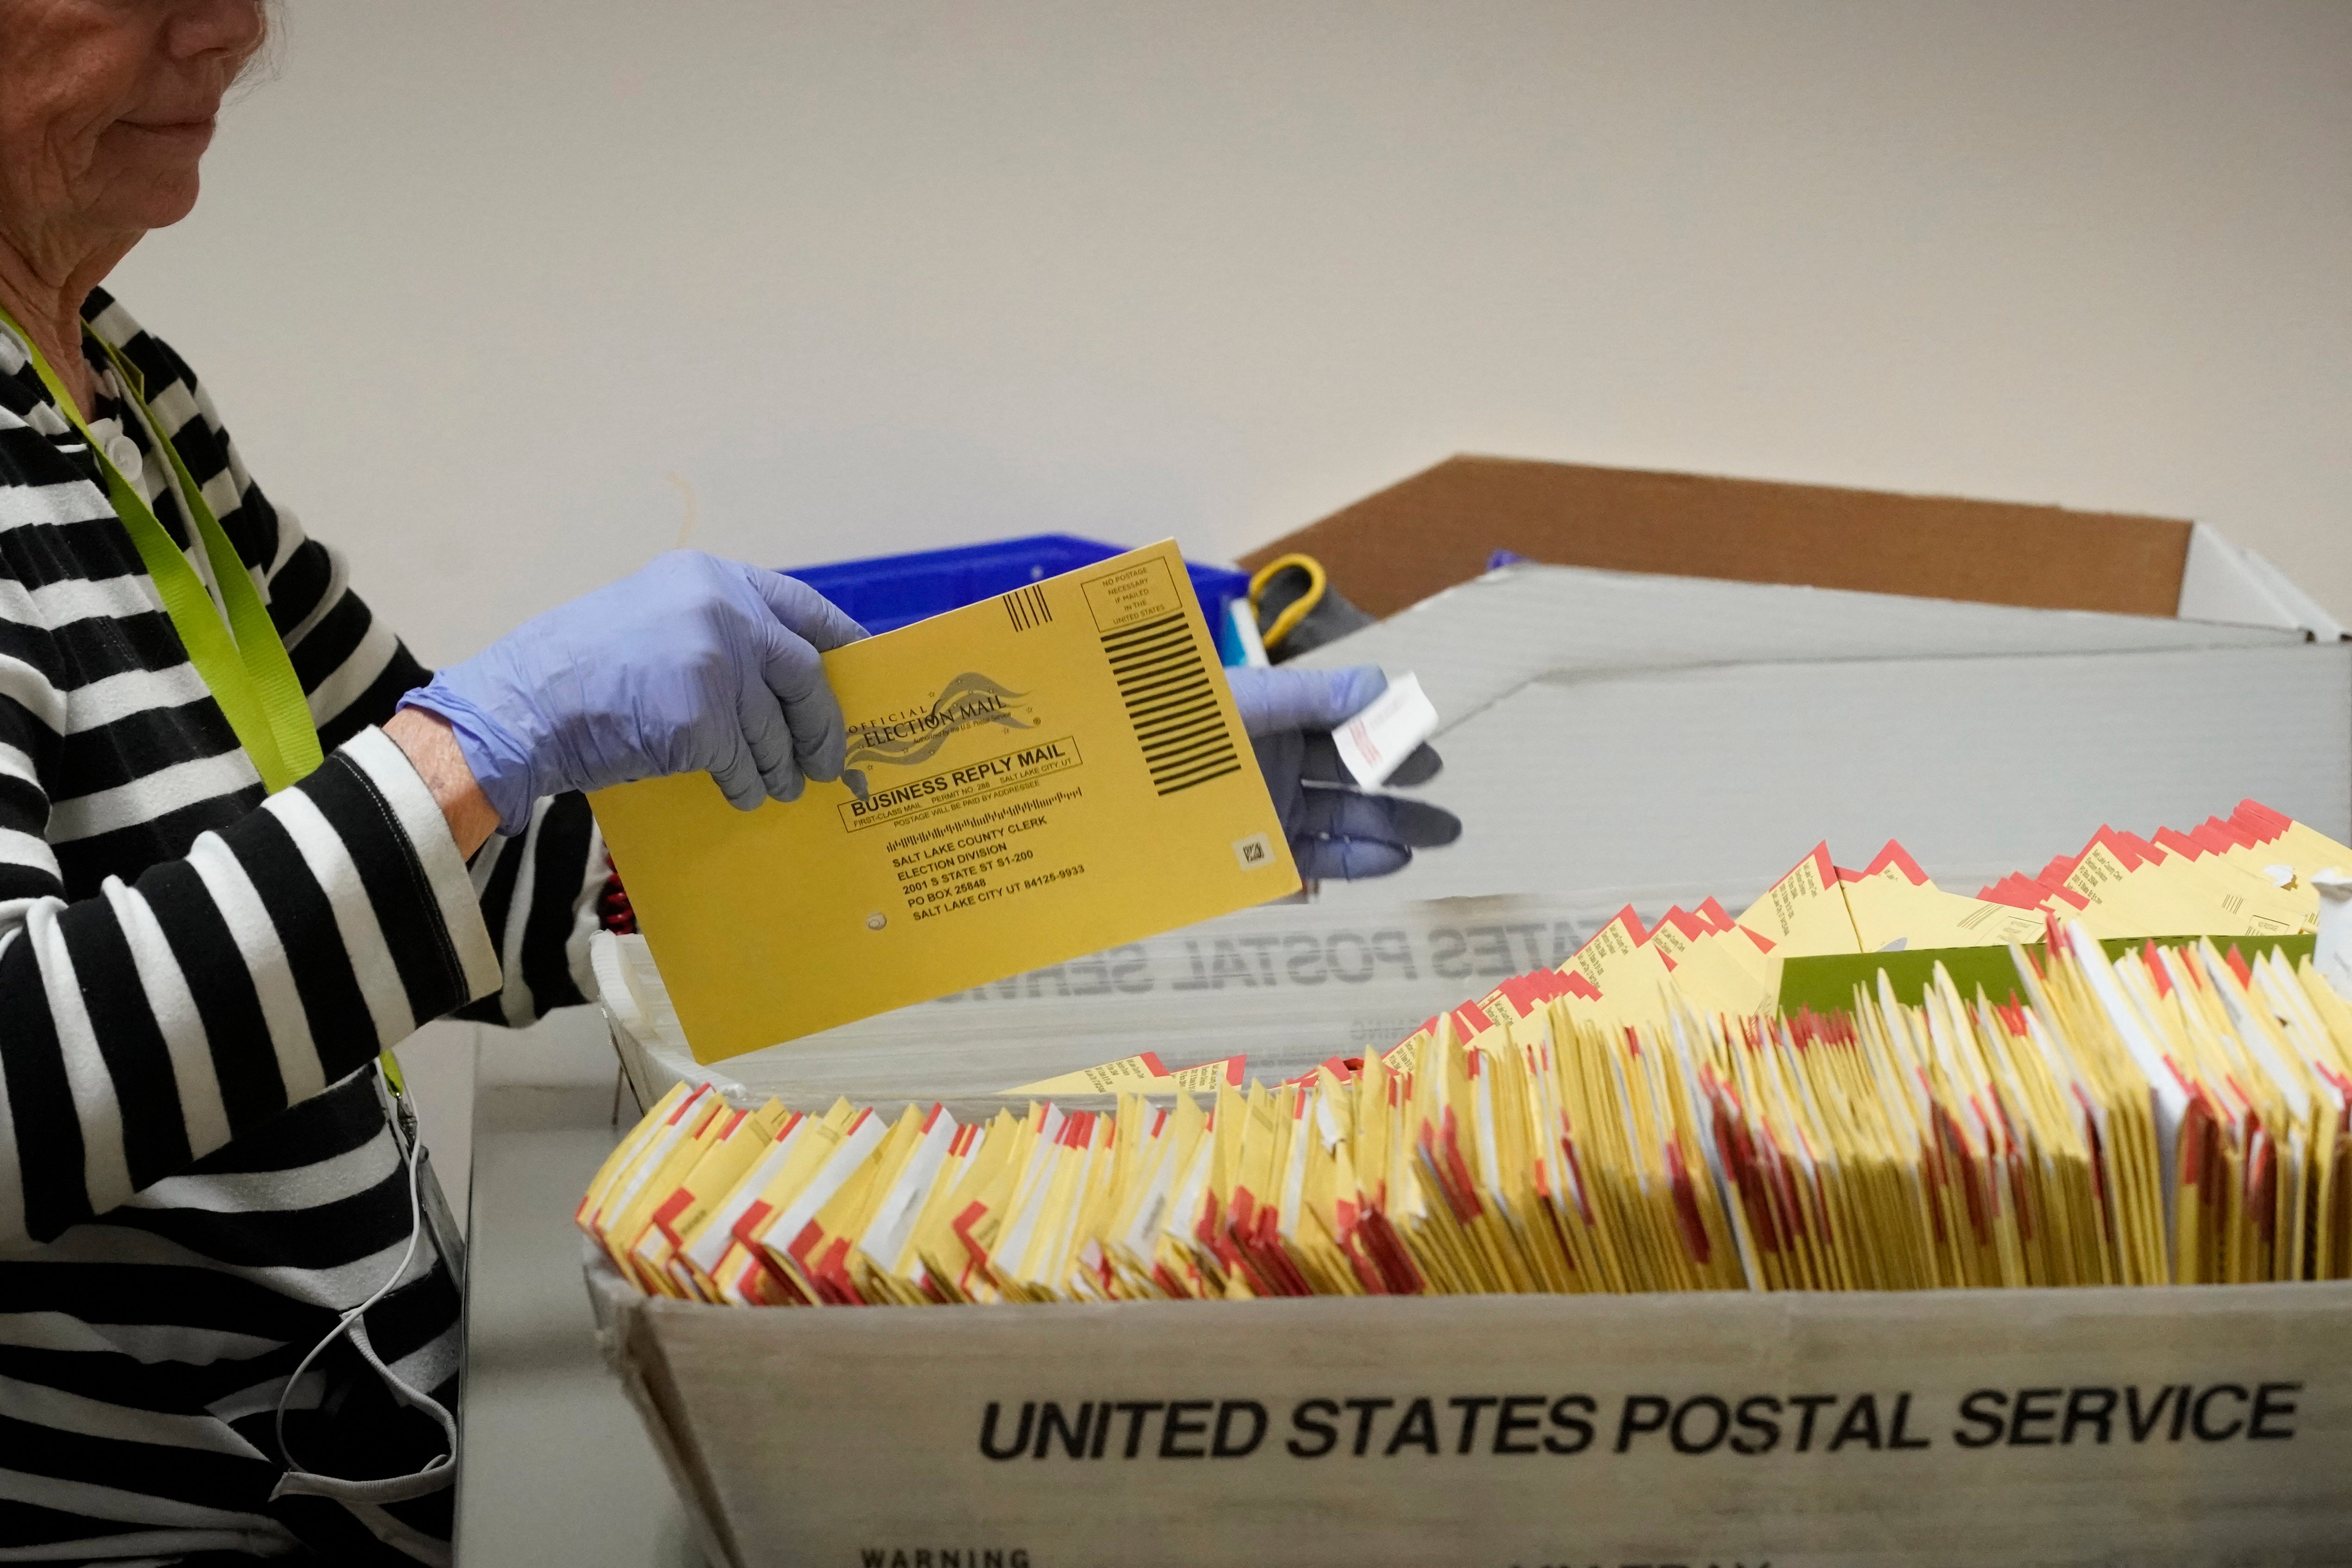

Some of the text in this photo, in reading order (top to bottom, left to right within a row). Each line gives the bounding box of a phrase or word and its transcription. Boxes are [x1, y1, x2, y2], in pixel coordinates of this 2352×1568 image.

[1102, 567, 1146, 587] NO POSTAGE
[1108, 578, 1148, 595] NECESSARY
[1122, 589, 1149, 601] MAILED
[1113, 604, 1165, 624] UNITED STATES
[1133, 600, 1147, 608] THE
[847, 704, 928, 735] OFFICIAL
[862, 693, 1007, 749] ELECTION MAIL
[972, 716, 991, 727] Postal
[851, 744, 1066, 817] BUSINESS REPLY MAIL
[853, 807, 902, 827] FIRST-CLASS
[904, 802, 921, 812] MAIL
[931, 790, 959, 804] PERMIT
[1000, 773, 1018, 784] SALT
[1019, 768, 1039, 778] LAKE
[1061, 757, 1071, 766] UT
[893, 812, 929, 828] POSTAGE
[931, 806, 950, 816] WILL
[962, 797, 980, 807] PAID
[981, 793, 991, 802] BY
[994, 780, 1038, 799] ADDRESSEE
[893, 816, 1047, 868] SALT LAKE COUNTY CLERK
[897, 842, 1007, 882] ELECTION DIVISION
[903, 850, 1033, 895] 2001 S STATE ST S1-200
[913, 865, 1085, 920] SALT LAKE CITY UT 84125-9933
[908, 879, 986, 908] PO BOX 25848
[979, 1383, 2302, 1460] UNITED STATES POSTAL SERVICE
